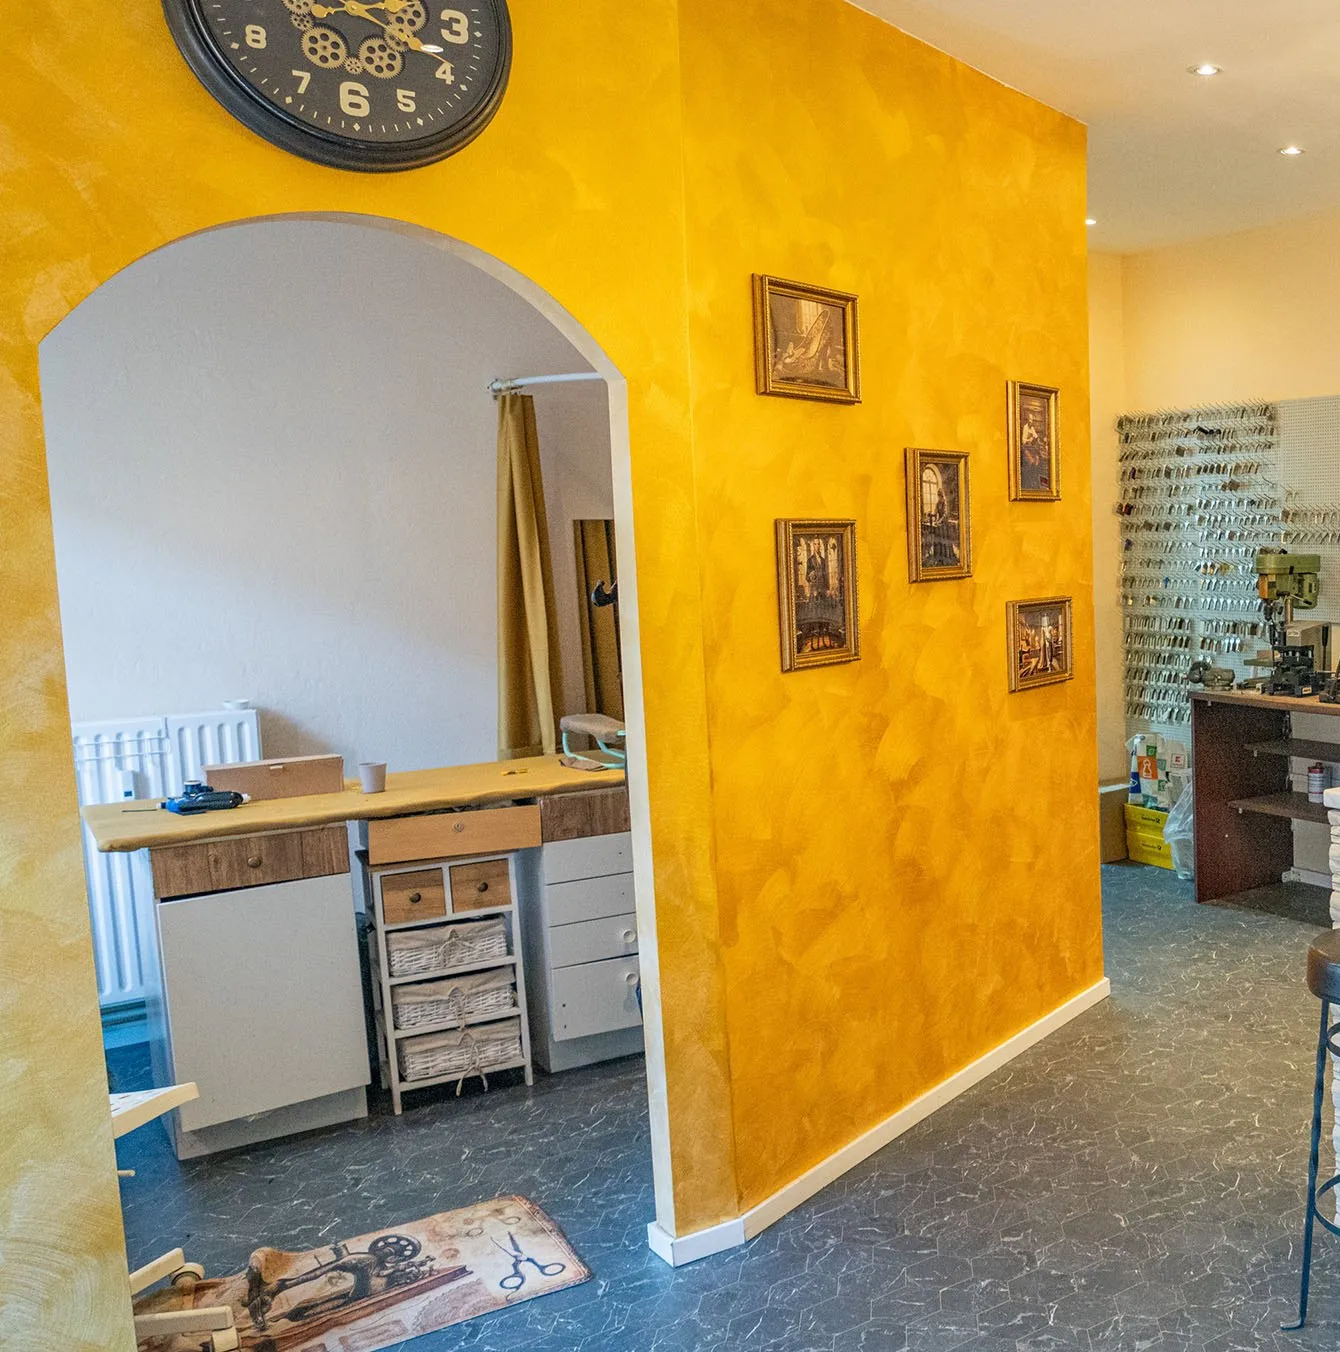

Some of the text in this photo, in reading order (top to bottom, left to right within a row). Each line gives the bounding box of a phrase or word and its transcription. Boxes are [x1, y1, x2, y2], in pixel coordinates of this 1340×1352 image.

[245, 24, 267, 49] 8
[440, 9, 469, 44] 3
[291, 69, 311, 94] 7
[435, 62, 454, 84] 4
[339, 81, 370, 117] 6
[396, 89, 416, 113] 5
